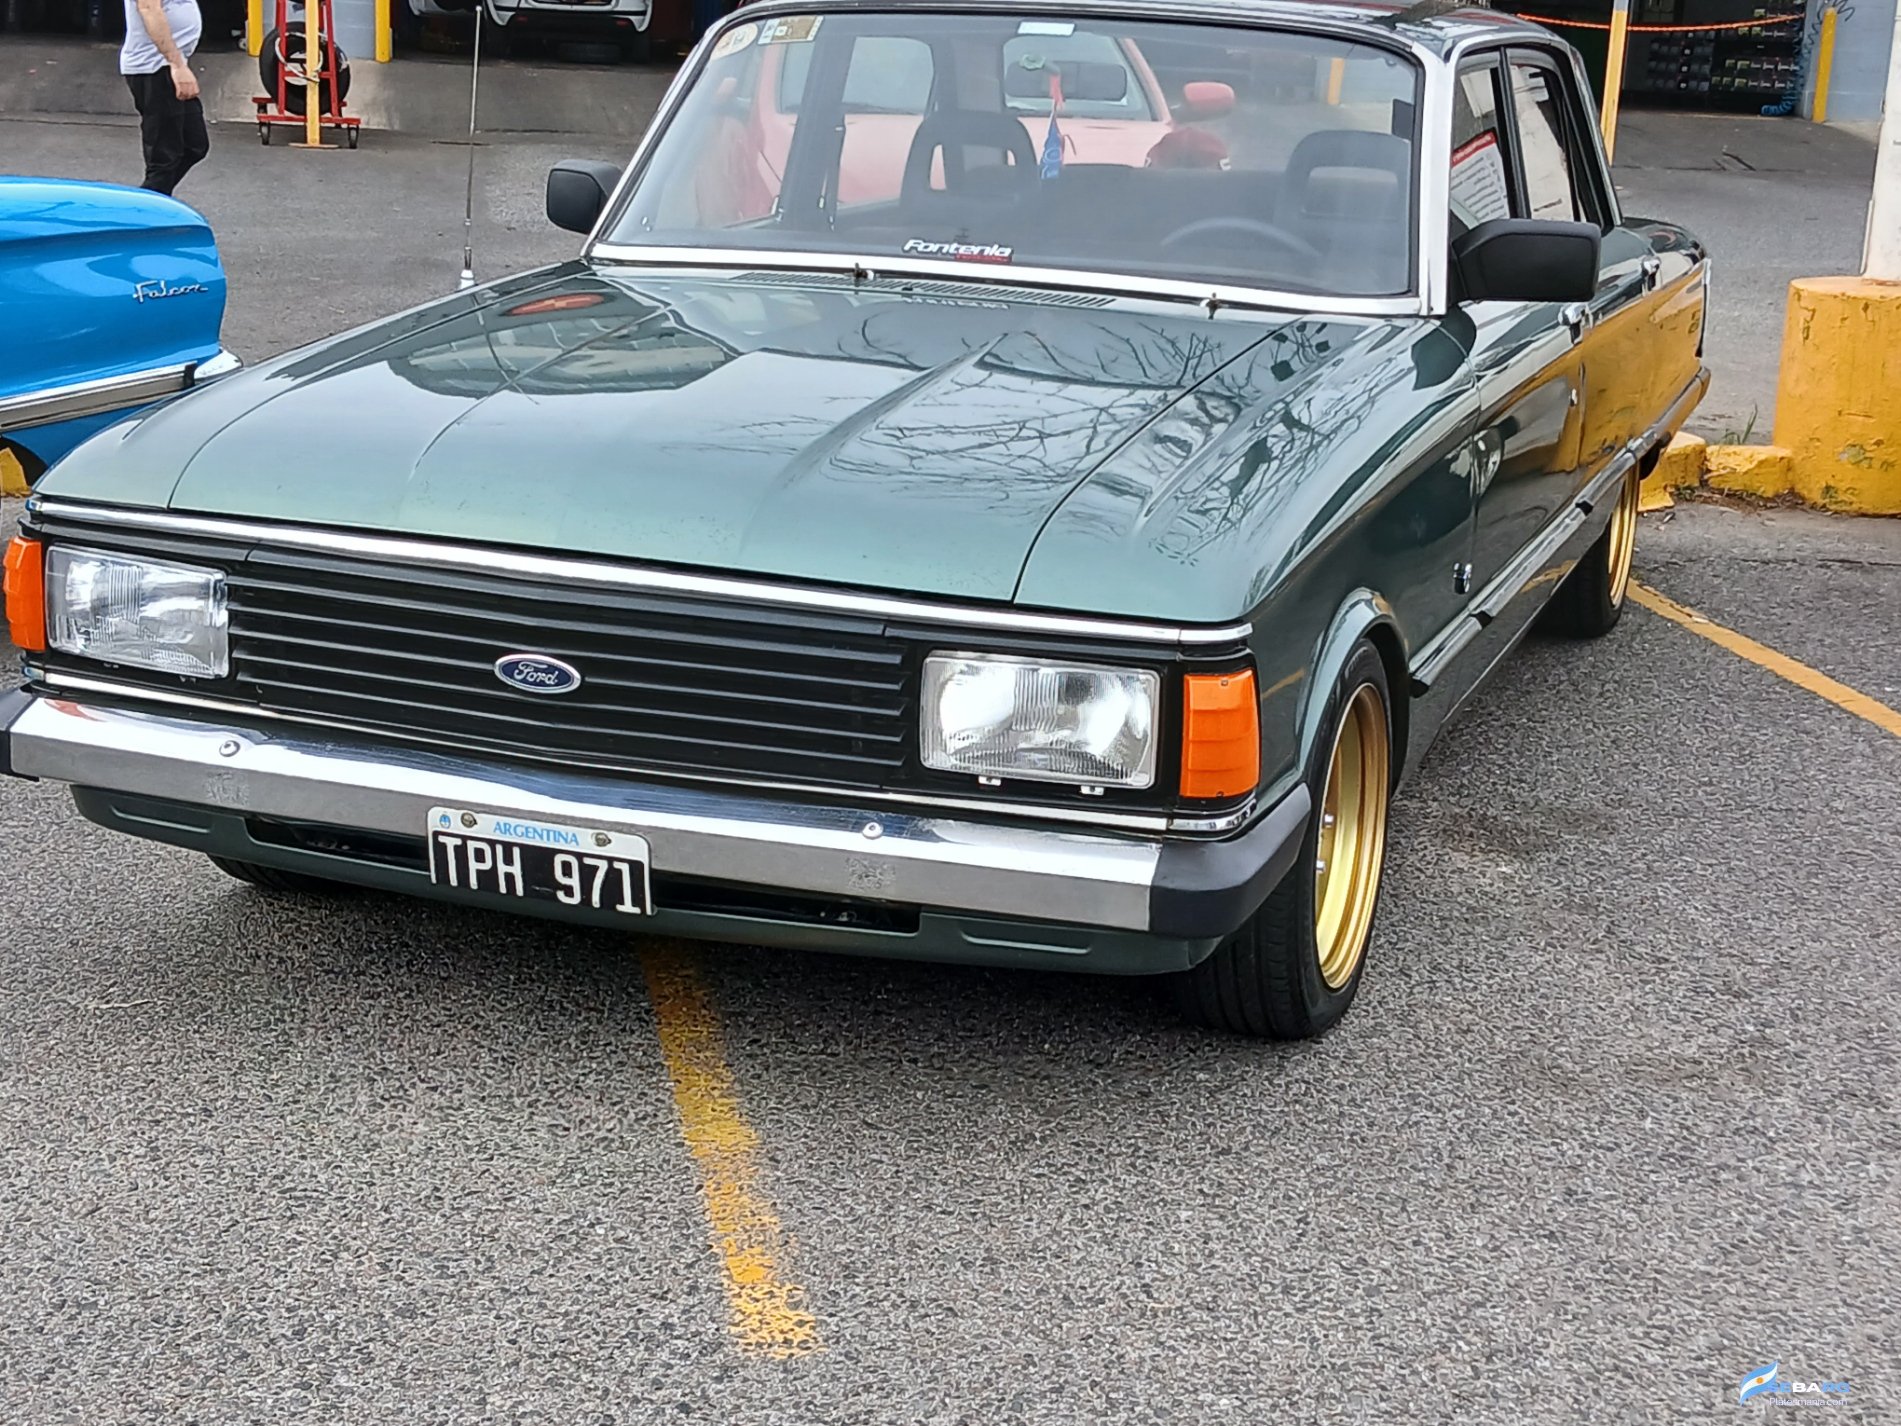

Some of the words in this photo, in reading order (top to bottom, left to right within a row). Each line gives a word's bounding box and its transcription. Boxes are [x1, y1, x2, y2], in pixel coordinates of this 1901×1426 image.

[903, 239, 1012, 257] Fontenla
[133, 279, 208, 303] Falcon
[513, 661, 559, 685] Ford
[493, 821, 580, 846] ARGENTINA
[438, 835, 523, 897] TPH
[553, 852, 642, 914] 971
